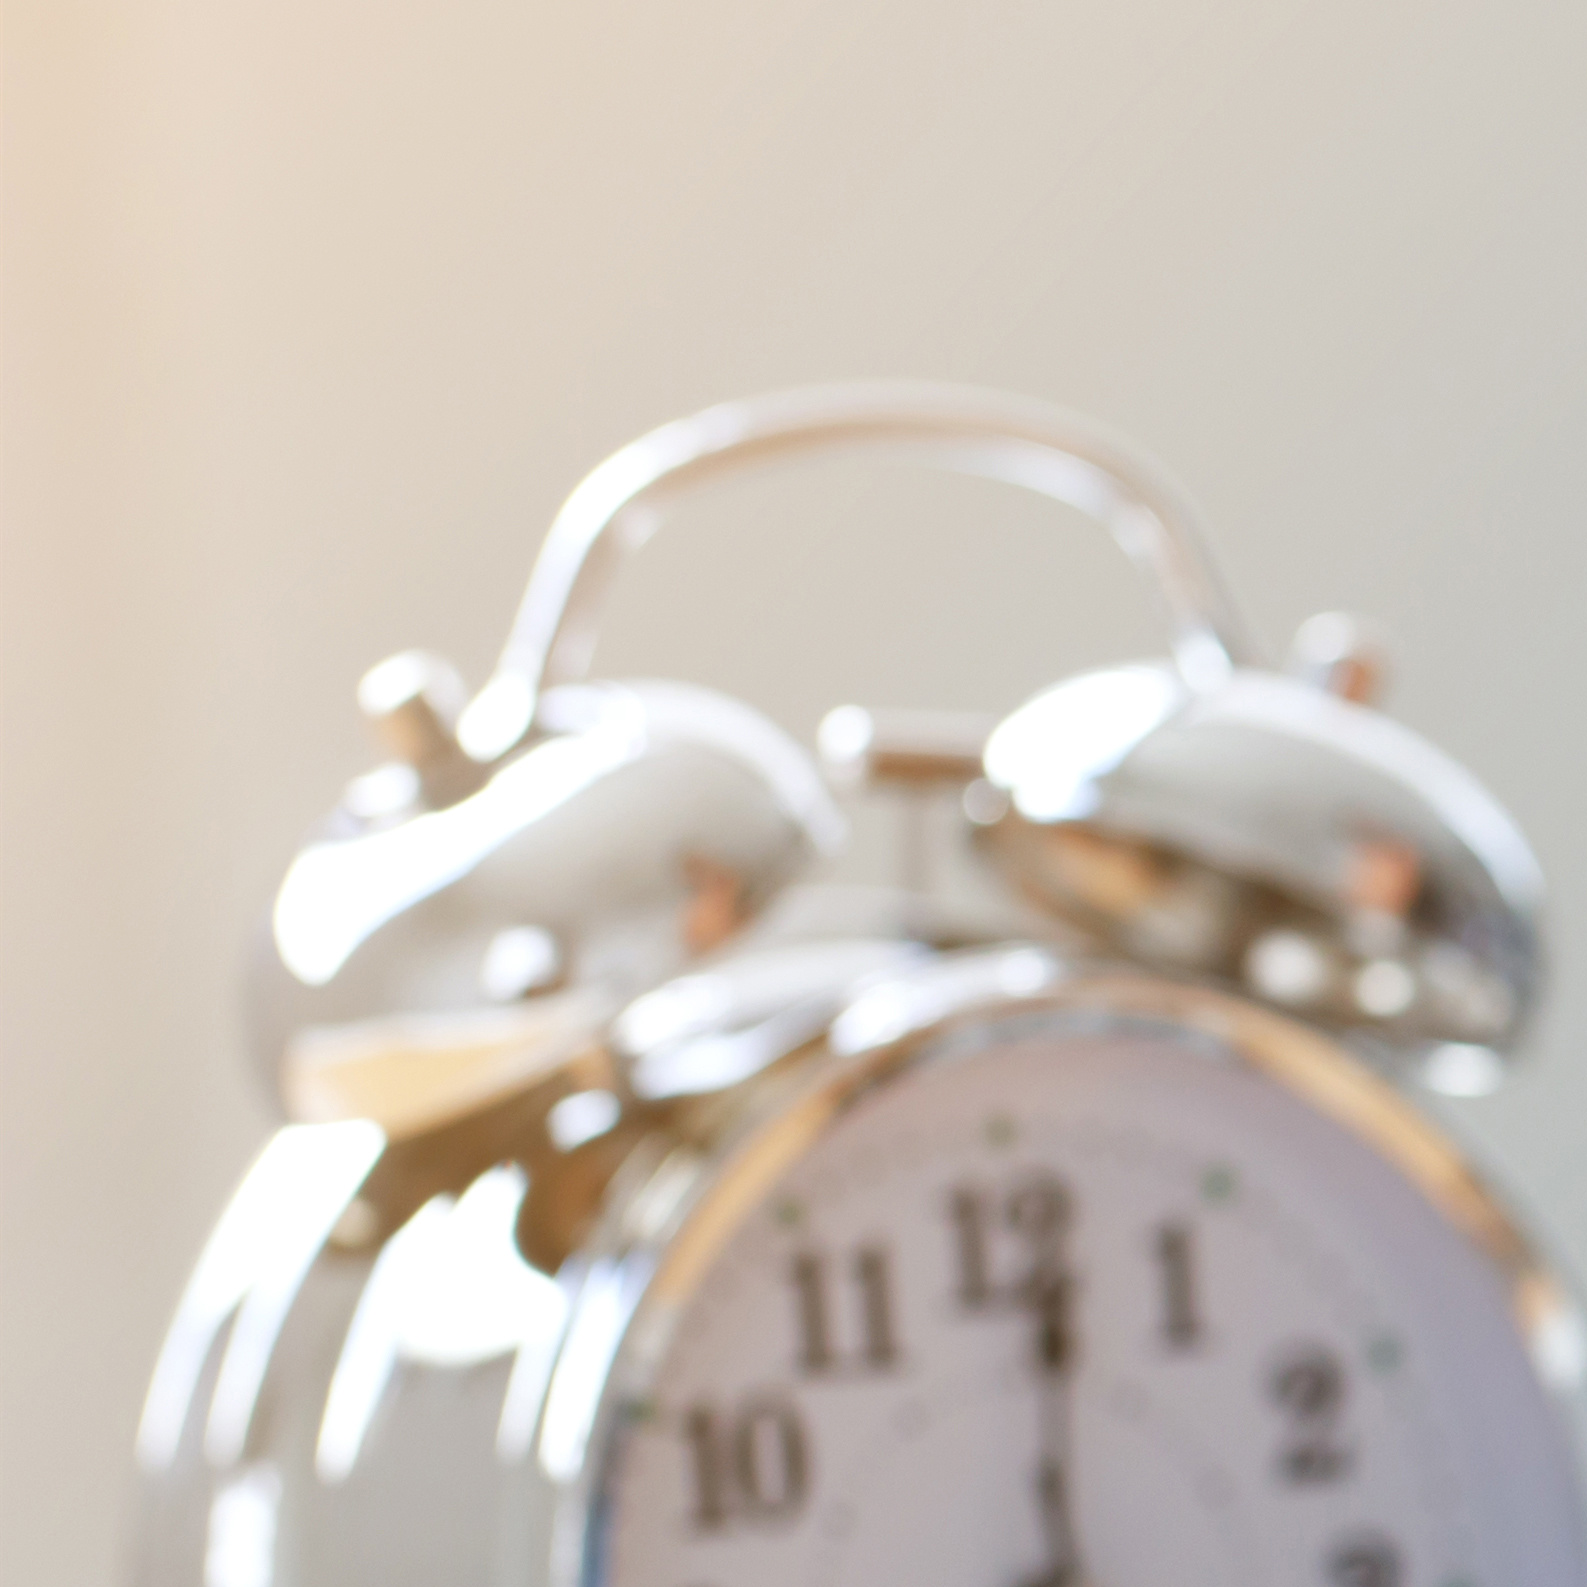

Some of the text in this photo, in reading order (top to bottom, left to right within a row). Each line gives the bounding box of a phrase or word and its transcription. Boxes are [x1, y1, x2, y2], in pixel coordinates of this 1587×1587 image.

[950, 1176, 1069, 1312] 12
[1155, 1226, 1206, 1348] 1
[796, 1249, 896, 1369] 11
[685, 1402, 806, 1530] 10
[1276, 1348, 1348, 1485] 2
